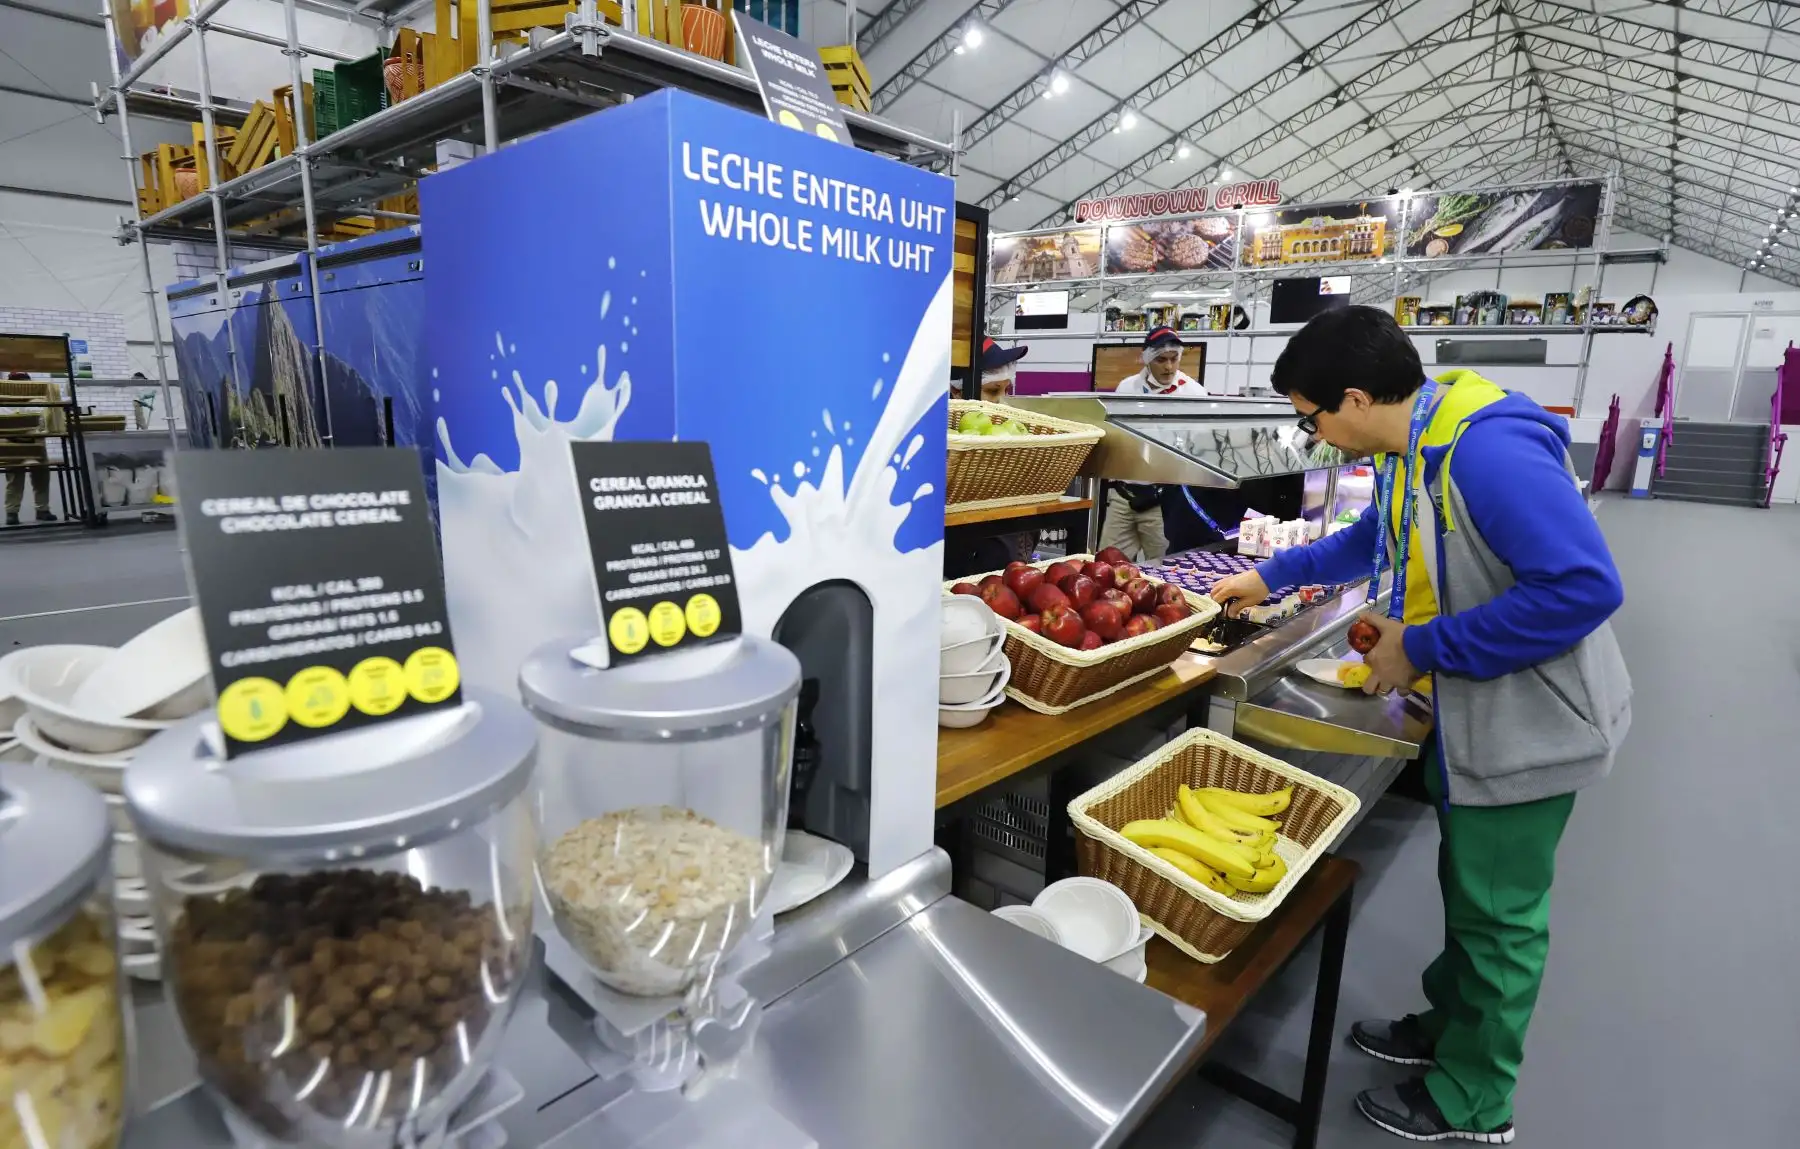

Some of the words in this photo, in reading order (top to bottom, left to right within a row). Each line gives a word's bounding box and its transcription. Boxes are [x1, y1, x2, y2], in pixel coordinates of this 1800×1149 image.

[682, 141, 783, 199] LECHE
[792, 169, 894, 224] ENTERA
[900, 197, 947, 234] UHT
[1075, 187, 1208, 222] DOWNTOWN
[1215, 180, 1281, 208] GRILL
[699, 198, 813, 253] WHOLE
[821, 224, 881, 265] MILK
[888, 238, 935, 273] UHT
[590, 476, 646, 492] CEREAL
[646, 474, 708, 490] GRANOLA
[201, 497, 280, 516] CEREAL
[280, 495, 308, 511] DE
[309, 490, 411, 510] CHOCOLATE
[593, 493, 661, 510] GRANOLA
[661, 491, 711, 506] CEREAL
[220, 511, 334, 534] CHOCOLATE
[334, 508, 403, 526] CEREAL
[325, 579, 357, 595] CAL
